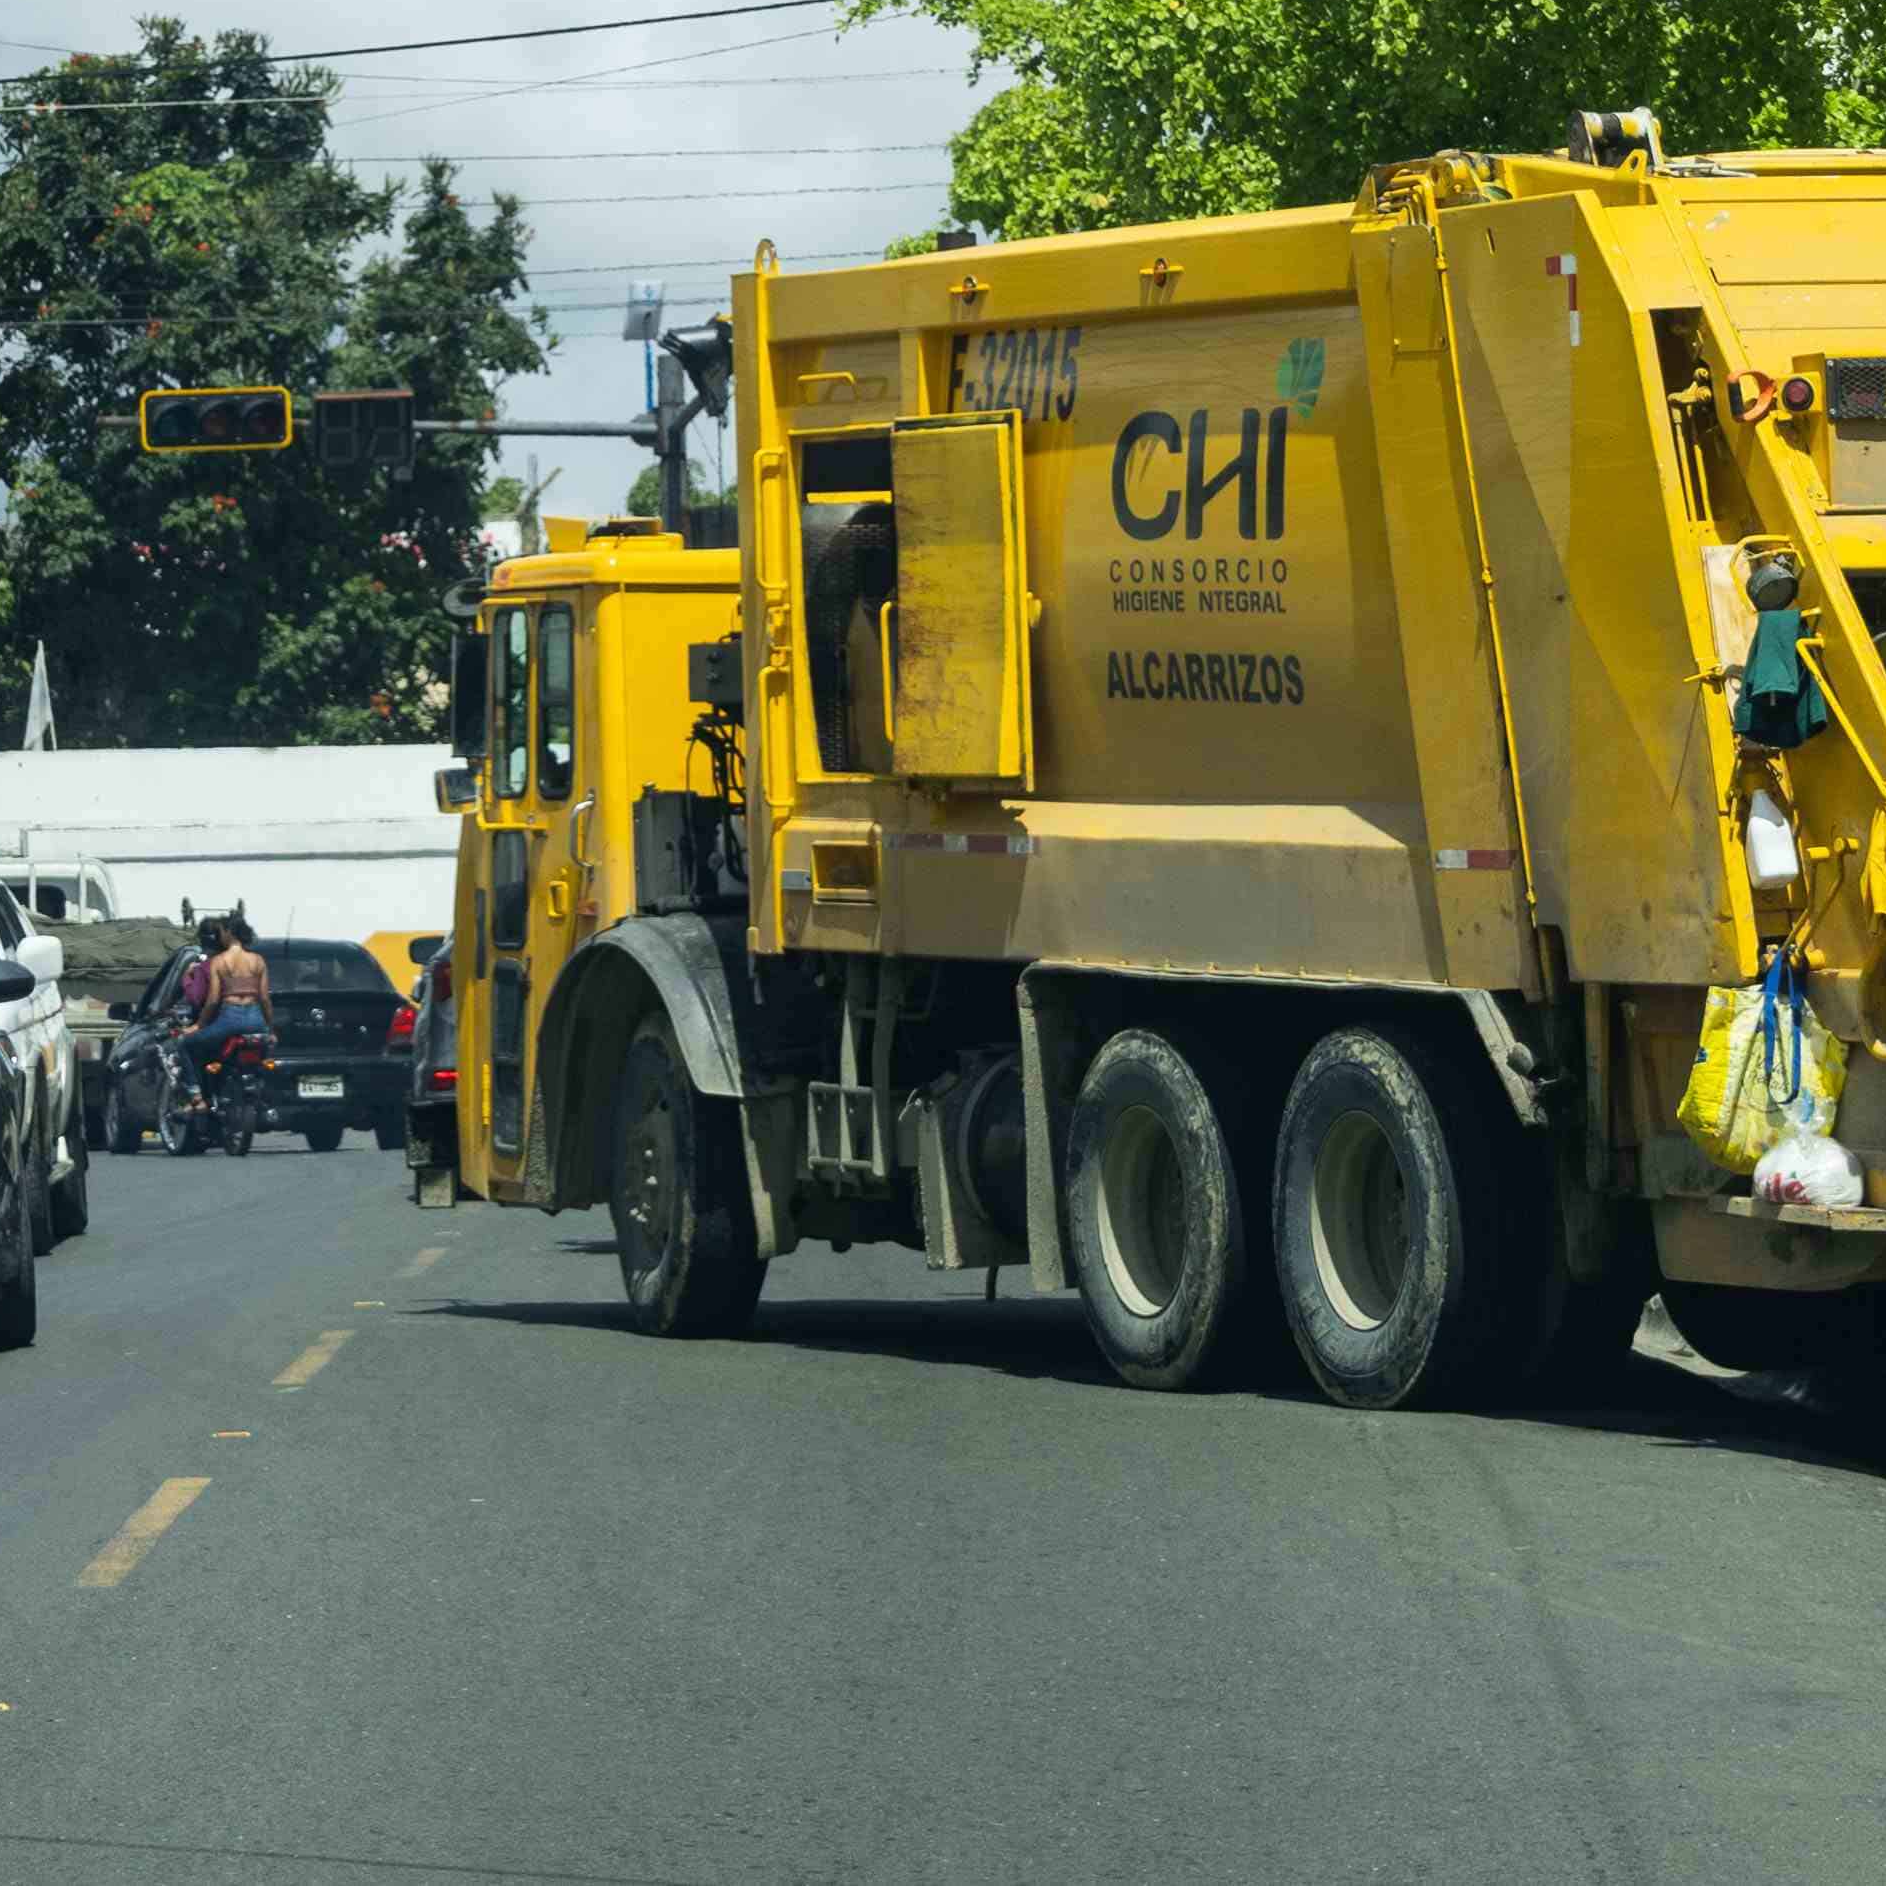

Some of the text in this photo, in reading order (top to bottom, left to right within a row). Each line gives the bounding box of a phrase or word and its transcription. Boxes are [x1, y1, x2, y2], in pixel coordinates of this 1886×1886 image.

[1111, 407, 1288, 540] CHI
[1110, 559, 1288, 583] CONSORCIO
[1114, 591, 1185, 612] HIGIENE
[1108, 651, 1304, 705] ALCARRIZOS
